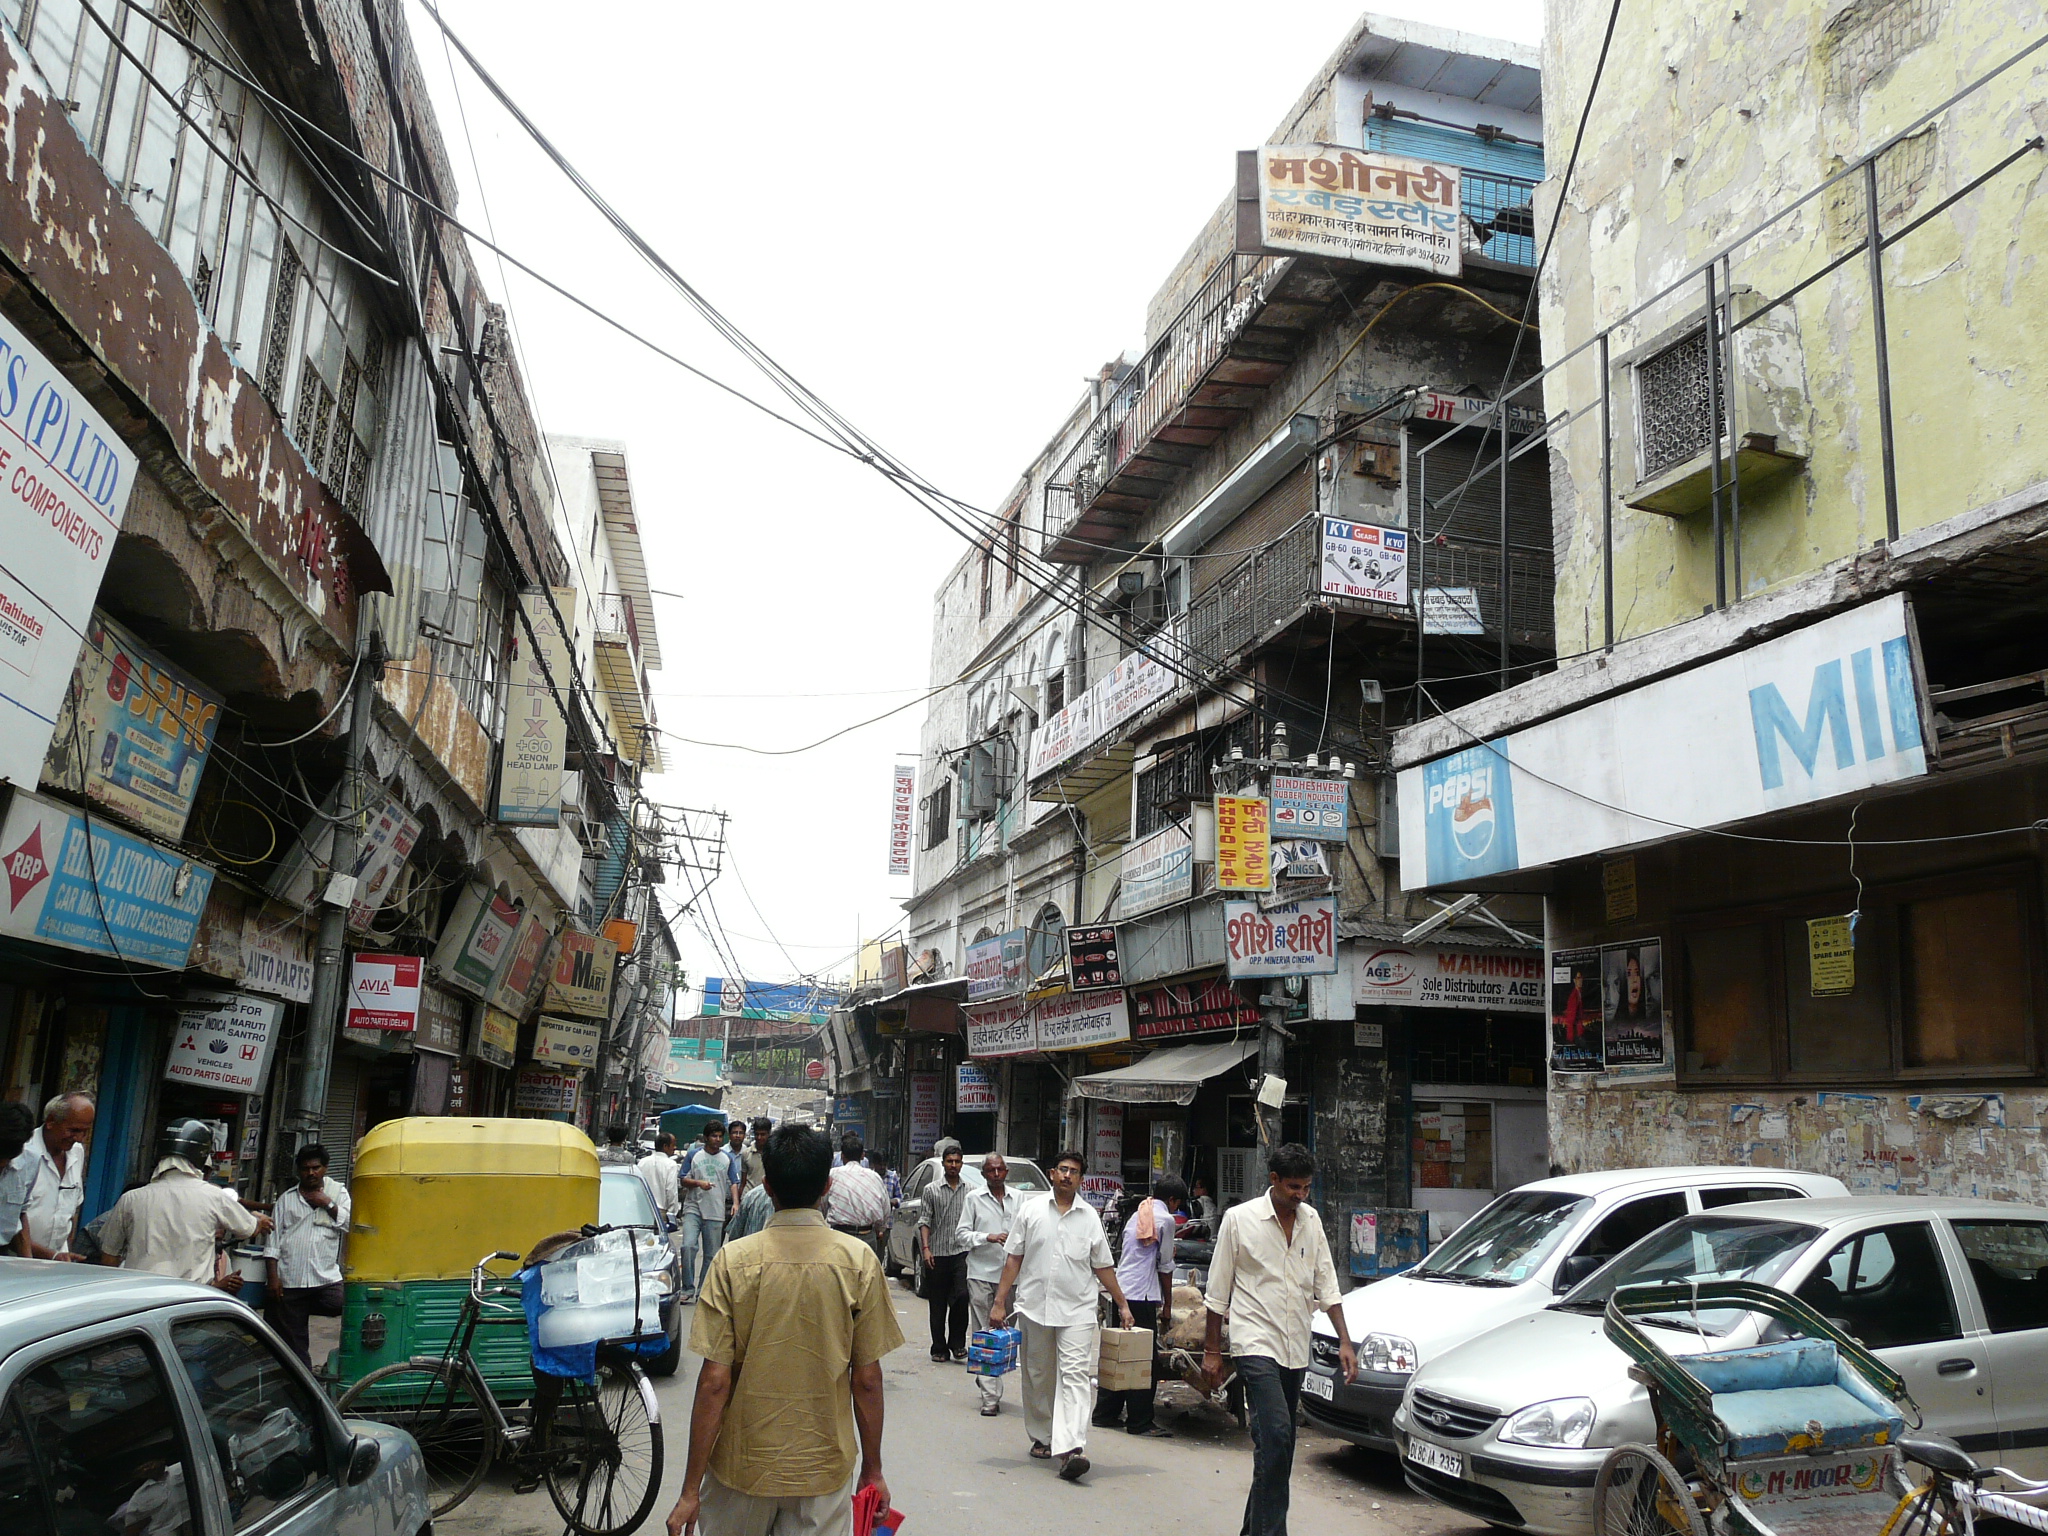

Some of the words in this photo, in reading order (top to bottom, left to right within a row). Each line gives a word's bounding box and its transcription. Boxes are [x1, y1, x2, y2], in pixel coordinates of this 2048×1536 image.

[1268, 152, 1457, 207] मशीनरी
[1365, 200, 1457, 232] स्टोर
[1367, 222, 1400, 241] सामान
[1401, 223, 1438, 247] मिलता
[1417, 247, 1451, 266] 3974377
[1426, 393, 1456, 421] JIT
[23, 379, 70, 469] (P)
[63, 417, 120, 518] LTD.
[11, 465, 103, 561] COMPONENTS
[1329, 522, 1350, 538] KY
[1324, 581, 1341, 593] JIT
[1344, 584, 1398, 601] INDUSTRIES
[1115, 685, 1148, 712] INDUSTRIES
[516, 739, 552, 754] +60
[506, 761, 532, 770] HEAD
[533, 762, 559, 771] LAMP
[518, 753, 549, 763] XENON
[1275, 778, 1346, 794] BINDHESHVERY
[1428, 766, 1492, 814] PEPSI
[1274, 790, 1302, 800] RUBBER
[1304, 792, 1345, 804] INDUSTRIES
[1305, 802, 1339, 811] SEAL
[1218, 796, 1237, 844] PHOTO
[61, 827, 111, 883] HIND
[10, 851, 42, 881] RBP
[1219, 849, 1239, 887] STAT
[54, 882, 77, 910] CAR
[113, 901, 140, 930] AUTO
[137, 908, 195, 944] ACCESSORIES
[1228, 912, 1275, 961] शीशे
[1274, 924, 1287, 949] ही
[1286, 908, 1334, 958] शीशे
[1264, 955, 1291, 966] MINERVA
[1291, 954, 1315, 965] CINEMA
[1813, 951, 1832, 960] SPARE
[1833, 949, 1852, 958] MART
[246, 950, 275, 983] AUTO
[274, 959, 311, 991] PARTS
[1366, 967, 1392, 978] AGE
[358, 978, 390, 993] AVIA
[1422, 977, 1443, 992] Sole
[1507, 981, 1538, 997] AGE
[240, 1004, 262, 1016] FOR
[1443, 994, 1476, 1003] MINERVA
[1508, 997, 1546, 1007] KASHMERE
[181, 1020, 203, 1031] FIAT
[204, 1017, 227, 1033] INDICA
[230, 1017, 267, 1031] MARUTI
[354, 1016, 370, 1025] AUTO
[370, 1017, 389, 1026] PARTS
[388, 1018, 409, 1028] (DELHI)
[227, 1028, 266, 1042] SANTRO
[572, 1027, 582, 1035] CAR
[582, 1029, 598, 1038] PARTS
[197, 1057, 234, 1070] VEHICLES
[169, 1064, 193, 1075] AUTO
[193, 1068, 221, 1081] PARTS
[221, 1072, 253, 1087] (DELHI)
[1096, 1129, 1121, 1138] JONGA
[1439, 1453, 1462, 1475] 2357
